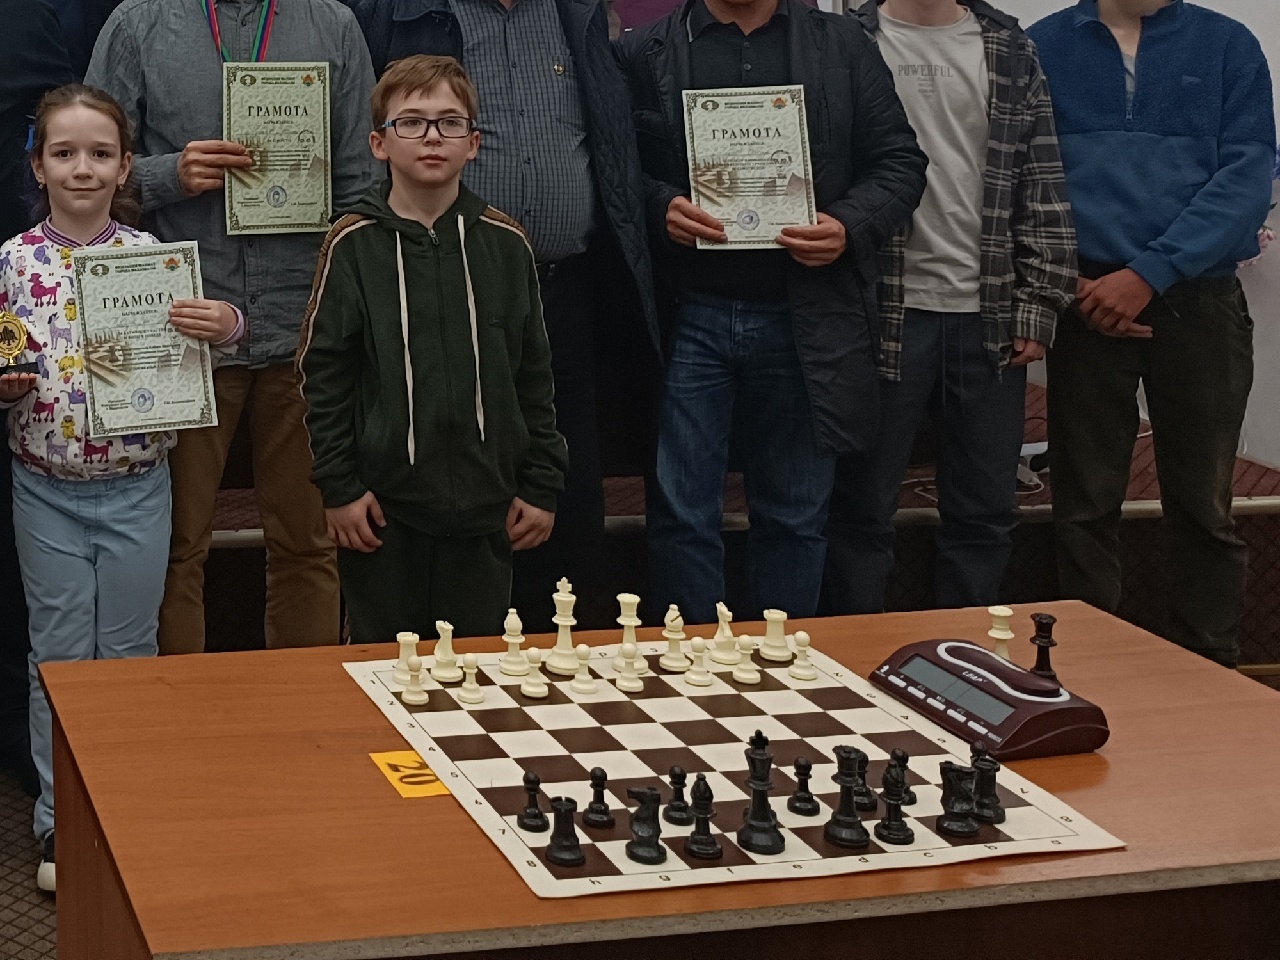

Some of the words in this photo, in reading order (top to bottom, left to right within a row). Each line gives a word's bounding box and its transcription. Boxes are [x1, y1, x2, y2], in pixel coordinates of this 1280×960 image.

[898, 64, 953, 78] POWERFUL
[248, 105, 308, 117] ГРАМОТА
[712, 127, 782, 140] ГРАМОТА
[102, 290, 174, 309] ГРАМОТА
[386, 760, 440, 786] 20
